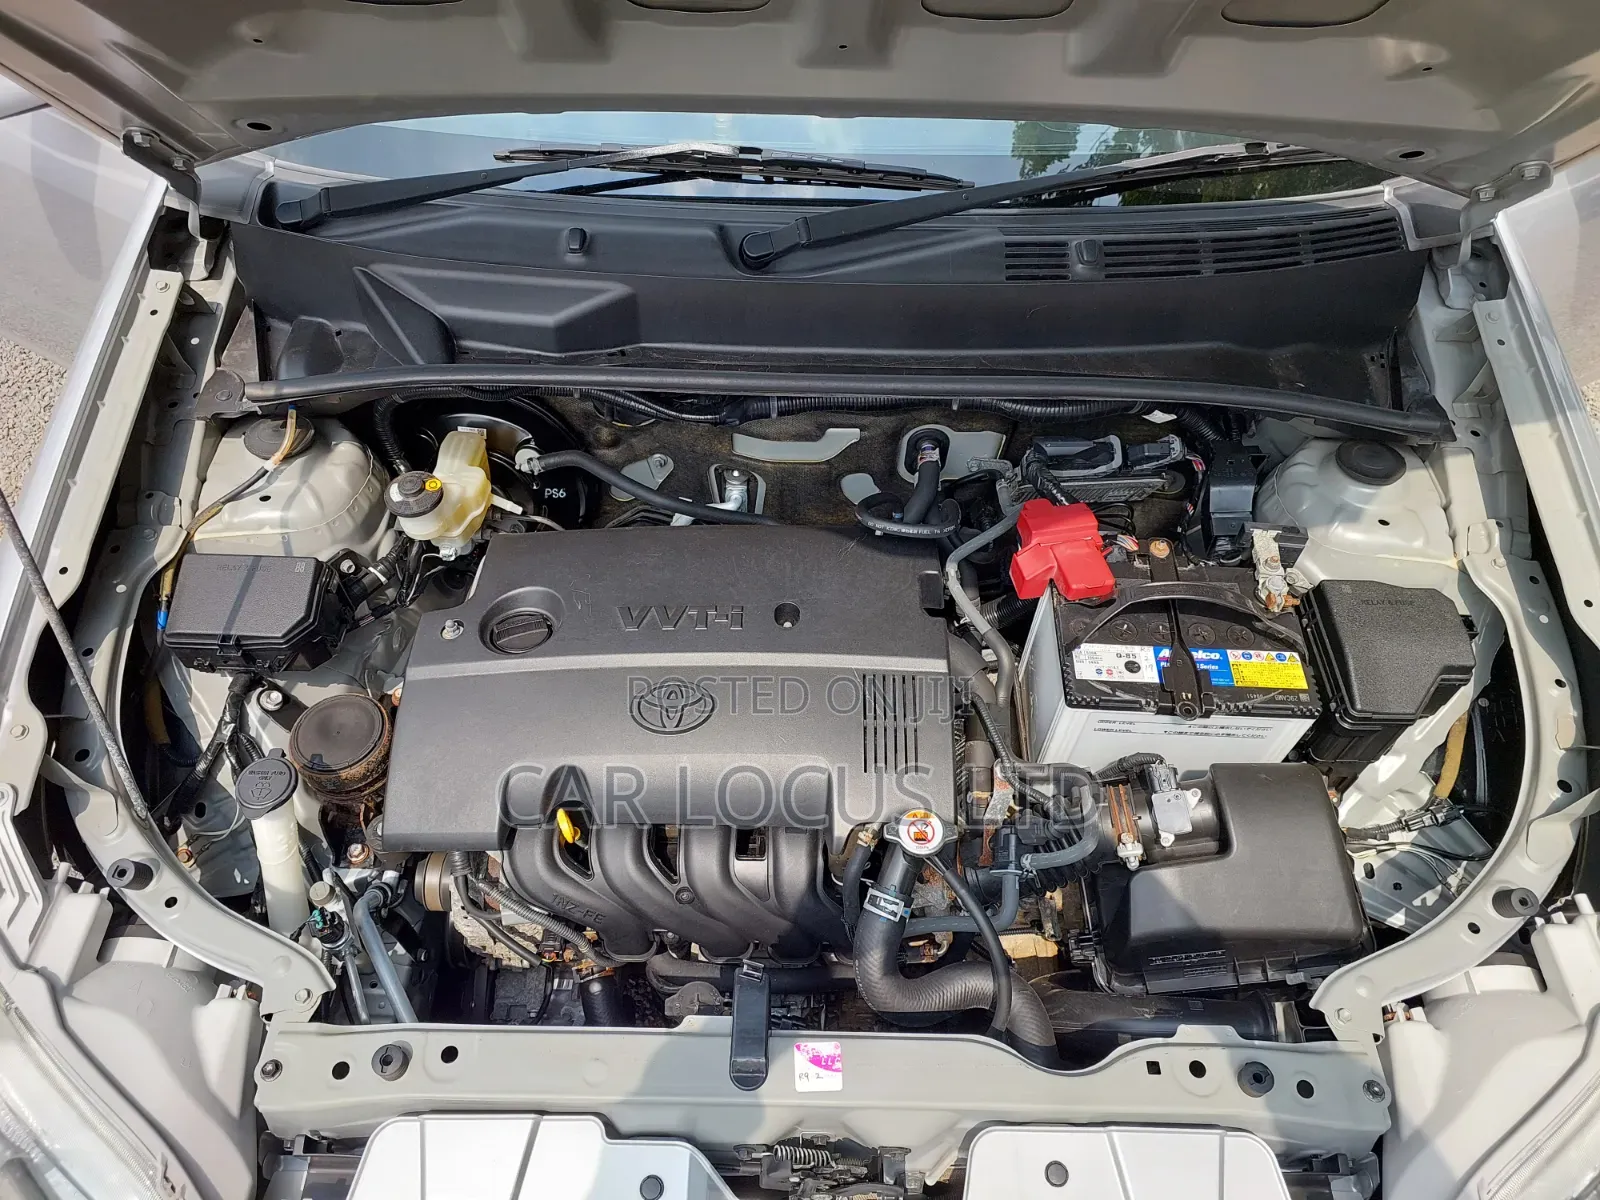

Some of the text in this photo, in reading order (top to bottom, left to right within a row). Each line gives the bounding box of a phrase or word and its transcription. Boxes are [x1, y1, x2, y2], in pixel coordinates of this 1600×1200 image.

[544, 487, 567, 498] PS6
[616, 605, 744, 631] VVT-i
[1156, 648, 1222, 661] Aelco
[551, 893, 607, 925] 1NZ-FE
